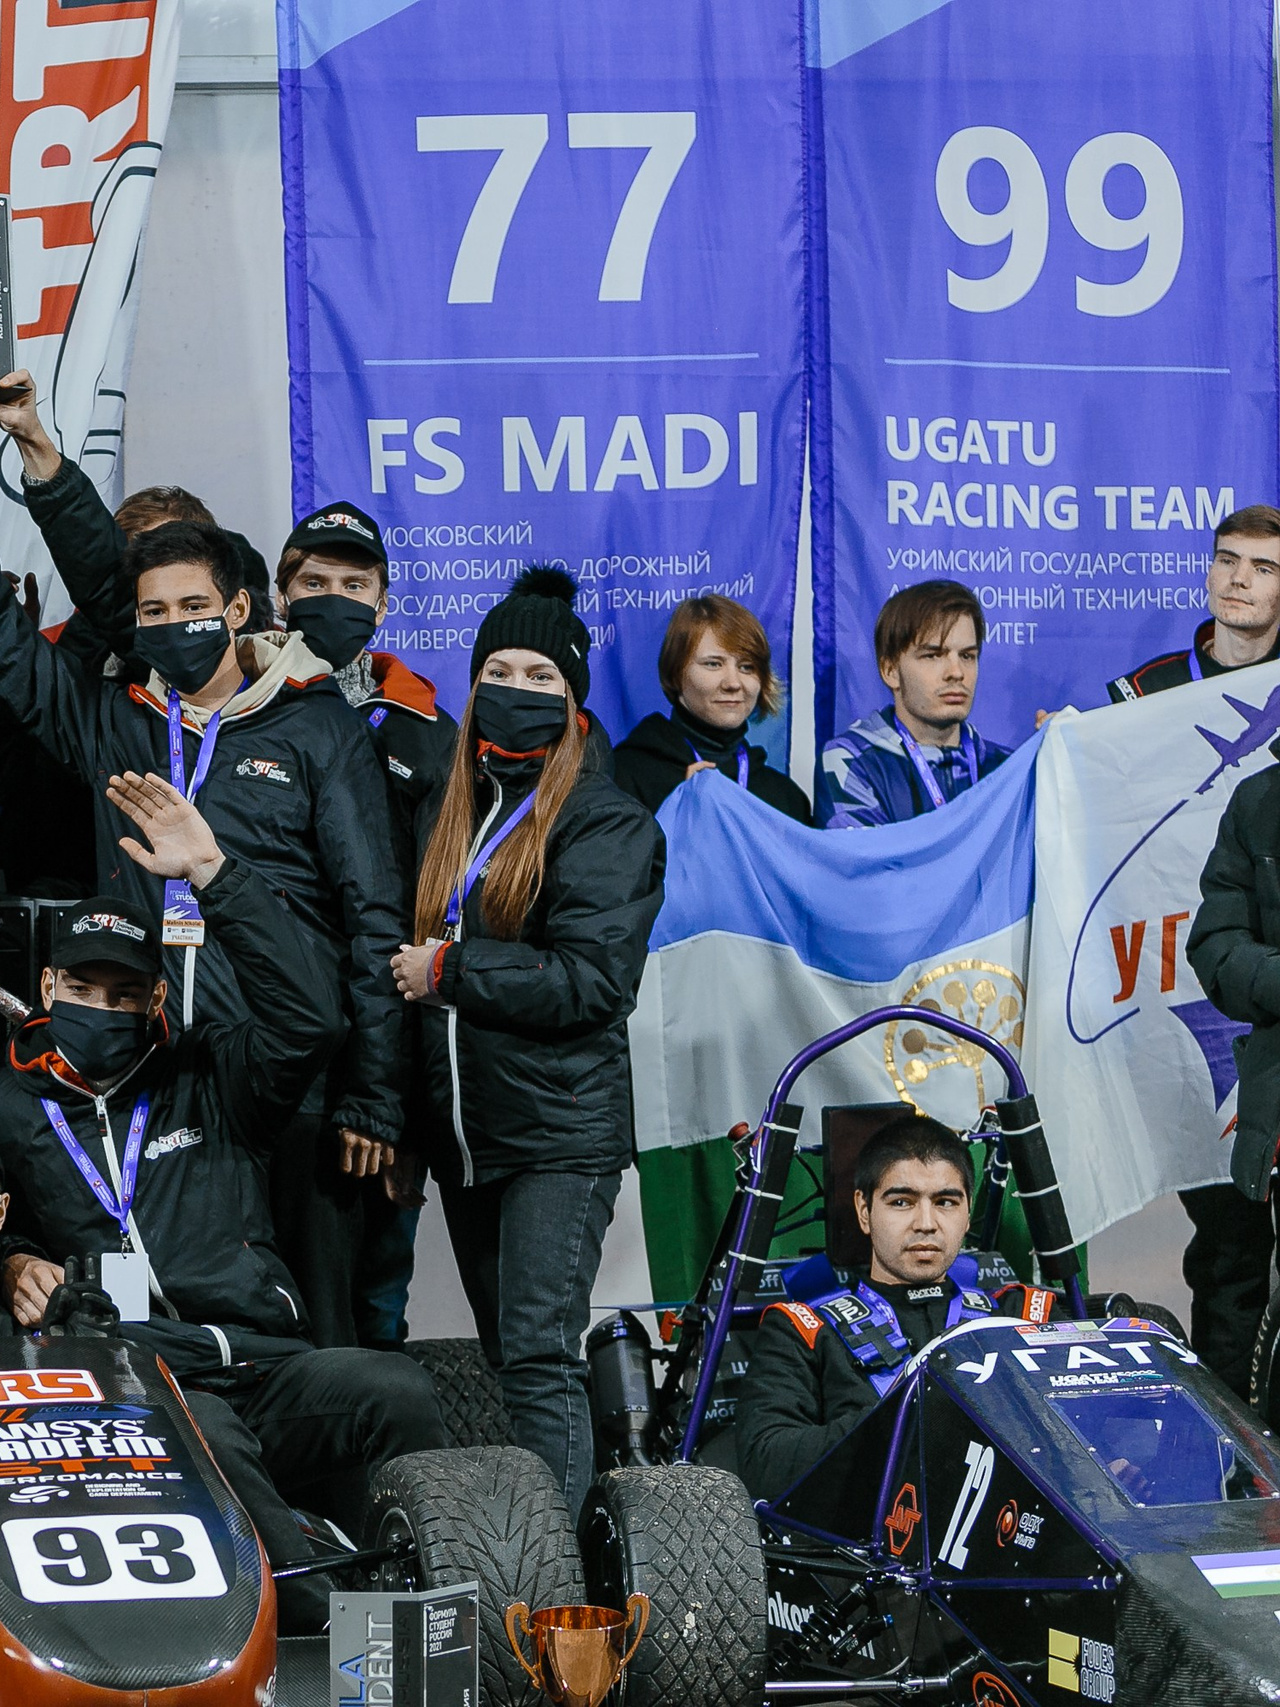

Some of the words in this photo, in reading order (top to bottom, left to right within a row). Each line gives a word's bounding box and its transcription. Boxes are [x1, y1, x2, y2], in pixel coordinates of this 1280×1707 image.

[416, 111, 697, 305] 77
[933, 125, 1184, 318] 99
[367, 416, 466, 495] FS
[502, 411, 758, 494] MADI
[885, 415, 1057, 467] UGATU
[886, 479, 1079, 531] RACING
[1094, 485, 1235, 531] TEAM
[886, 546, 1013, 573] УФИМСКИЙ
[1020, 551, 1213, 580] ГОСУДАРСТВЕНН
[1072, 586, 1210, 611] ТЕХНИЧЕСКИ
[370, 627, 477, 651] УНИВЕРС
[955, 1340, 1199, 1384] УГАТУ
[37, 1404, 100, 1414] racing
[938, 1440, 995, 1571] 12
[32, 1523, 197, 1587] 93
[428, 1607, 458, 1621] ФОРМУЛА
[428, 1617, 456, 1632] СТУДЕНТ
[428, 1628, 453, 1642] РОССИЯ
[428, 1641, 442, 1653] 2021
[1081, 1636, 1115, 1674] FODES
[1080, 1667, 1116, 1704] GROUP
